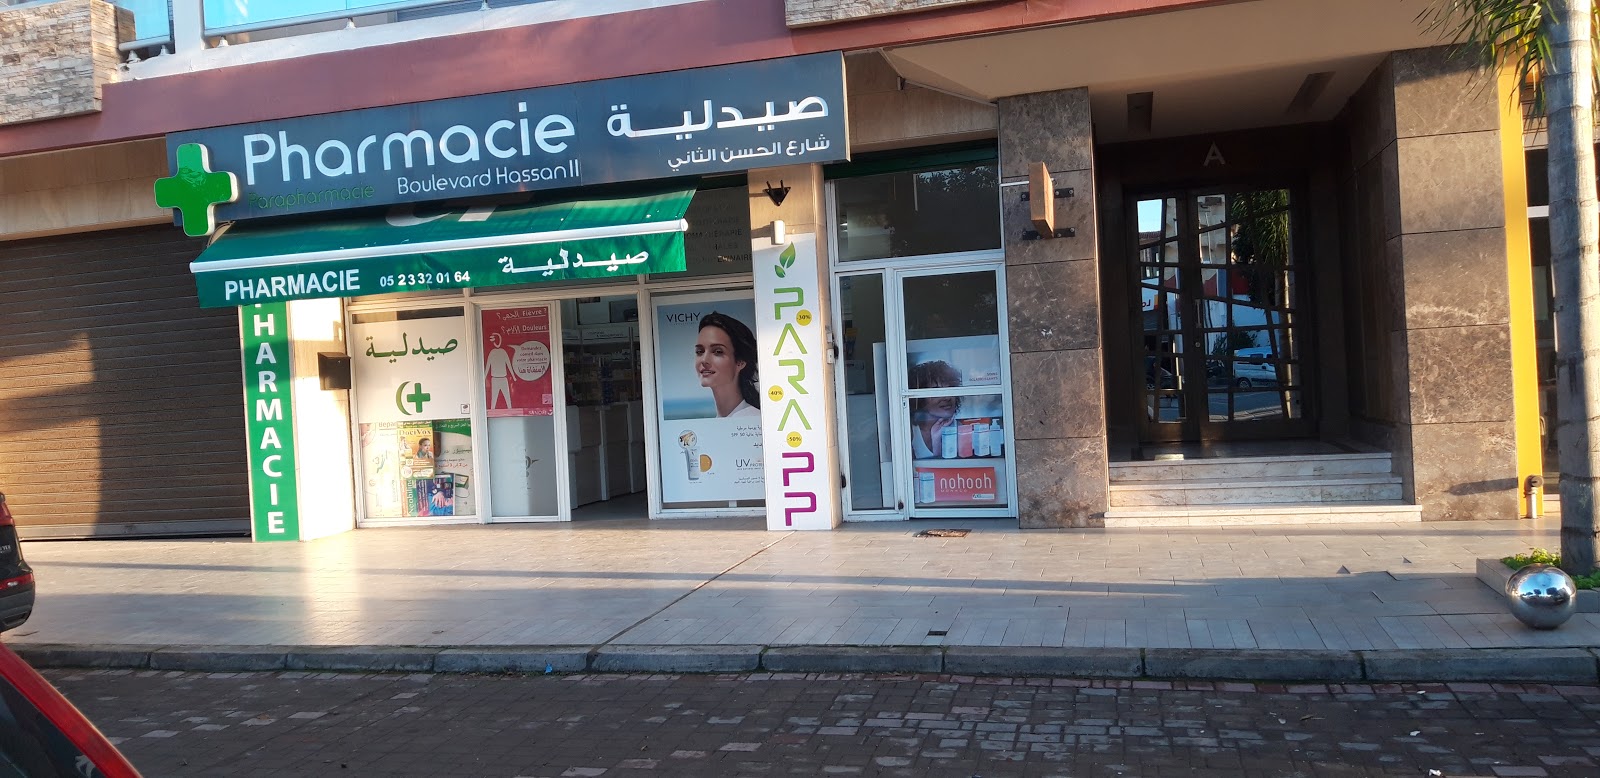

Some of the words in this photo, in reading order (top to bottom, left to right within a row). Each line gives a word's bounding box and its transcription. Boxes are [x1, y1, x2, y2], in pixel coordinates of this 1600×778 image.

[607, 96, 829, 140] صيدلية
[243, 101, 576, 185] Pharmacie
[720, 142, 782, 163] الحسن
[785, 134, 830, 156] شارع
[1204, 141, 1226, 166] A
[667, 147, 716, 171] الثاني
[397, 168, 491, 195] Boulevard
[248, 185, 376, 210] Parapharmacie
[497, 248, 649, 277] صيدلية
[224, 268, 361, 300] PHARMACIE
[379, 275, 395, 287] 05
[397, 273, 416, 286] 23
[417, 272, 433, 284] 32
[436, 271, 450, 284] 01
[454, 270, 471, 282] 64
[666, 312, 701, 323] VICHY
[366, 332, 458, 363] صيدلية
[253, 303, 285, 534] HARMACIE
[735, 458, 750, 468] UV
[940, 472, 992, 489] nohooh
